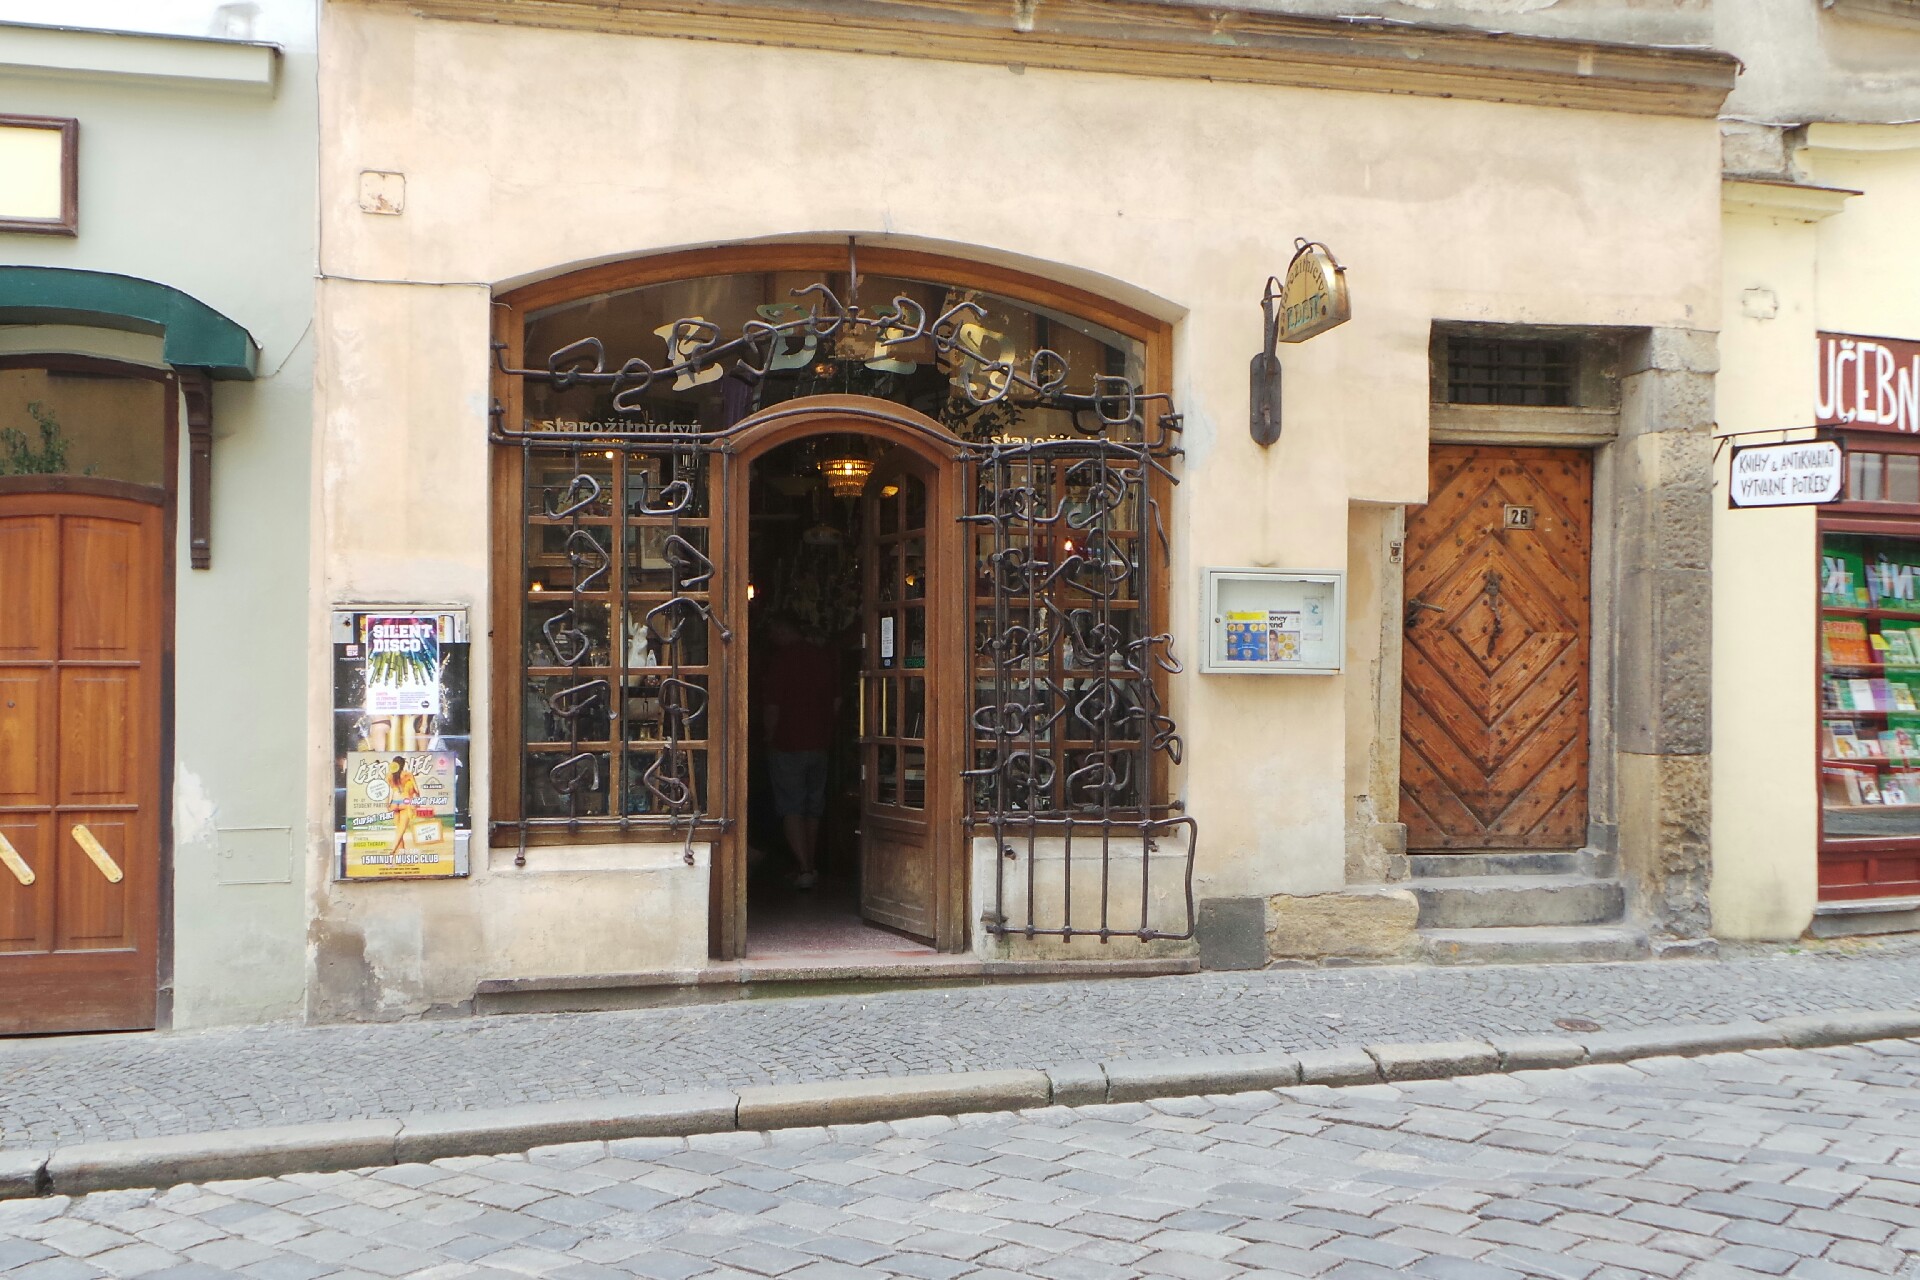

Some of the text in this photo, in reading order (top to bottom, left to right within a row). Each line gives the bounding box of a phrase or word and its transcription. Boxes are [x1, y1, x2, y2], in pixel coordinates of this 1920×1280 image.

[1738, 454, 1769, 473] KNIHY
[1771, 461, 1778, 472] &
[1512, 509, 1528, 525] 26
[372, 624, 433, 638] SILENT
[373, 638, 421, 652] DISCO
[353, 755, 433, 784] ČERNEC
[361, 853, 439, 865] 15MINUT MUSIC CLUB
